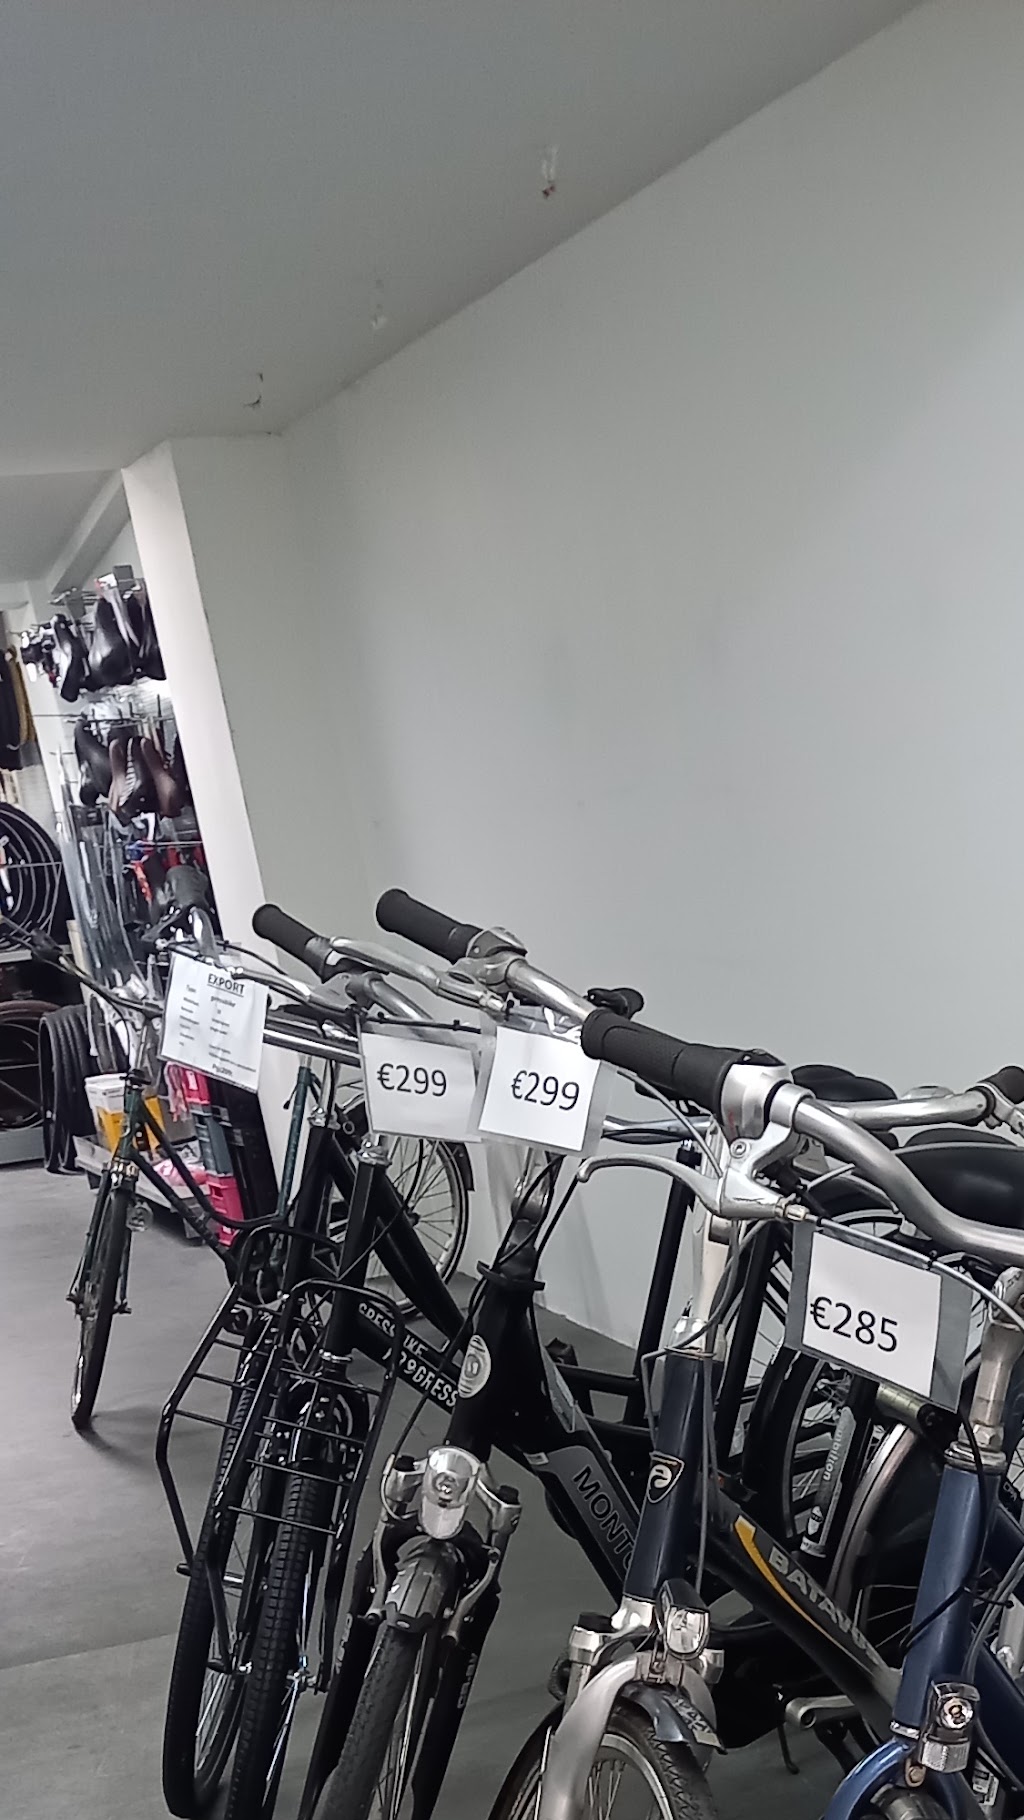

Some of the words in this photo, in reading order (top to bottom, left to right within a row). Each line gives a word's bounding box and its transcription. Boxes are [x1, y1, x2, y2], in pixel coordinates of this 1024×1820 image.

[207, 973, 245, 995] EXPORT
[376, 1063, 448, 1097] €299
[510, 1070, 580, 1111] €299
[809, 1296, 898, 1352] €285
[573, 1465, 636, 1571] MONT
